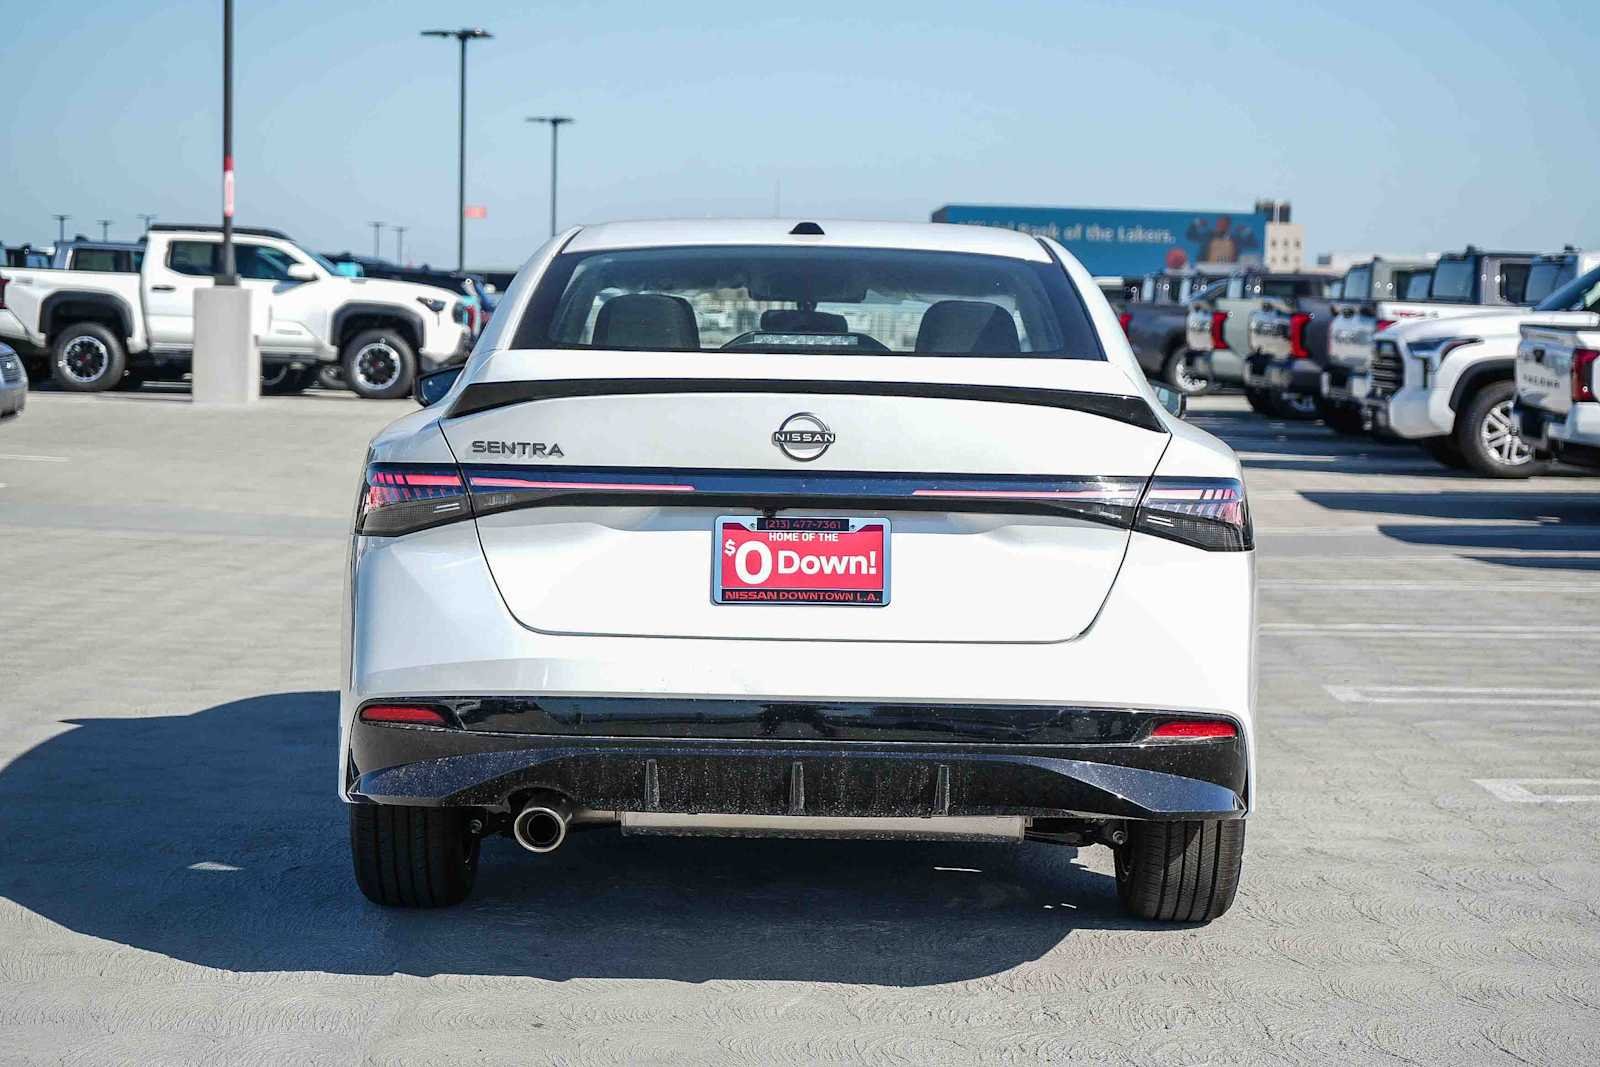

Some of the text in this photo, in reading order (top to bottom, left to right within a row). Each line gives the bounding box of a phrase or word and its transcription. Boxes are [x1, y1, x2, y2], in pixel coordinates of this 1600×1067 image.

[1064, 222, 1082, 240] of
[1086, 223, 1113, 241] the
[774, 431, 835, 443] NISSAN
[472, 440, 564, 457] SENTRA
[769, 532, 839, 542] HOME OF THE
[777, 550, 877, 575] Down!
[725, 591, 880, 602] NISSAN DOWNTOWN L.A.
